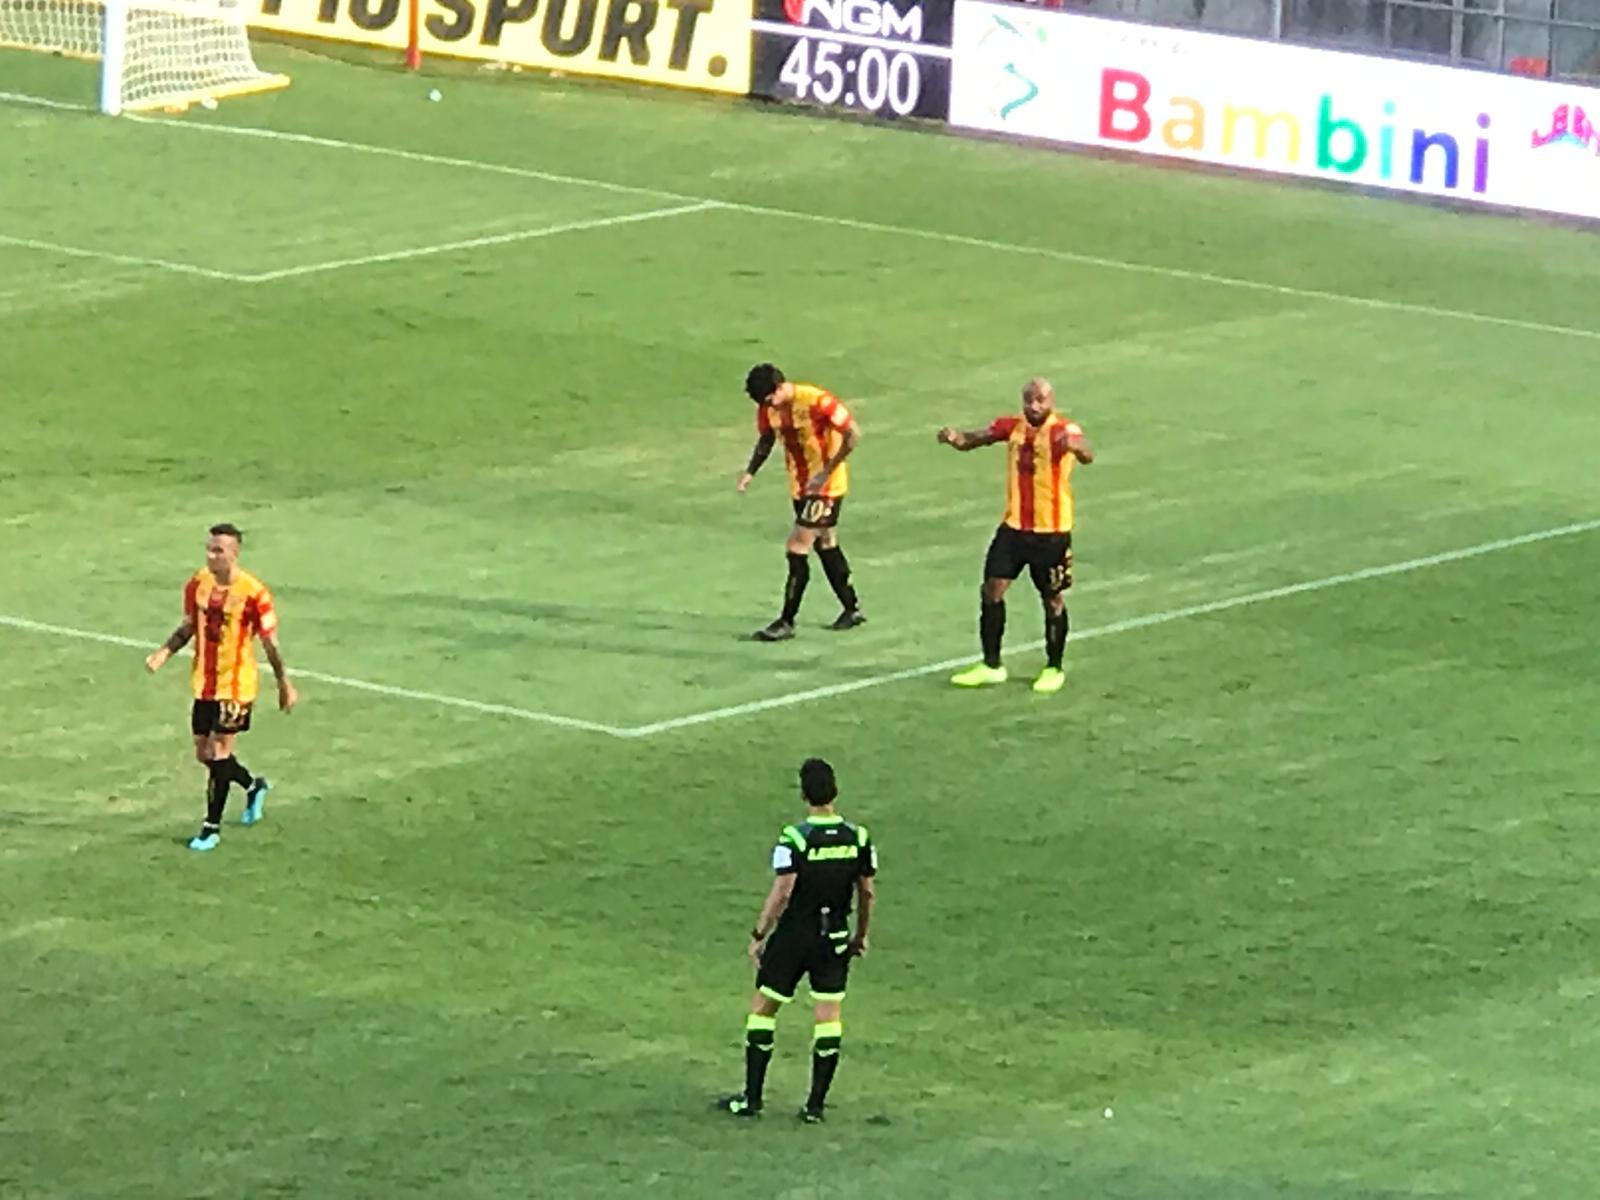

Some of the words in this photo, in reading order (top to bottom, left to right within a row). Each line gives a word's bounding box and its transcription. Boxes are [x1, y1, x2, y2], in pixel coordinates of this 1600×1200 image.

[424, 0, 728, 77] SPORT.
[801, 0, 923, 42] NGM
[779, 37, 921, 115] 45:00
[1098, 66, 1489, 194] Bambini
